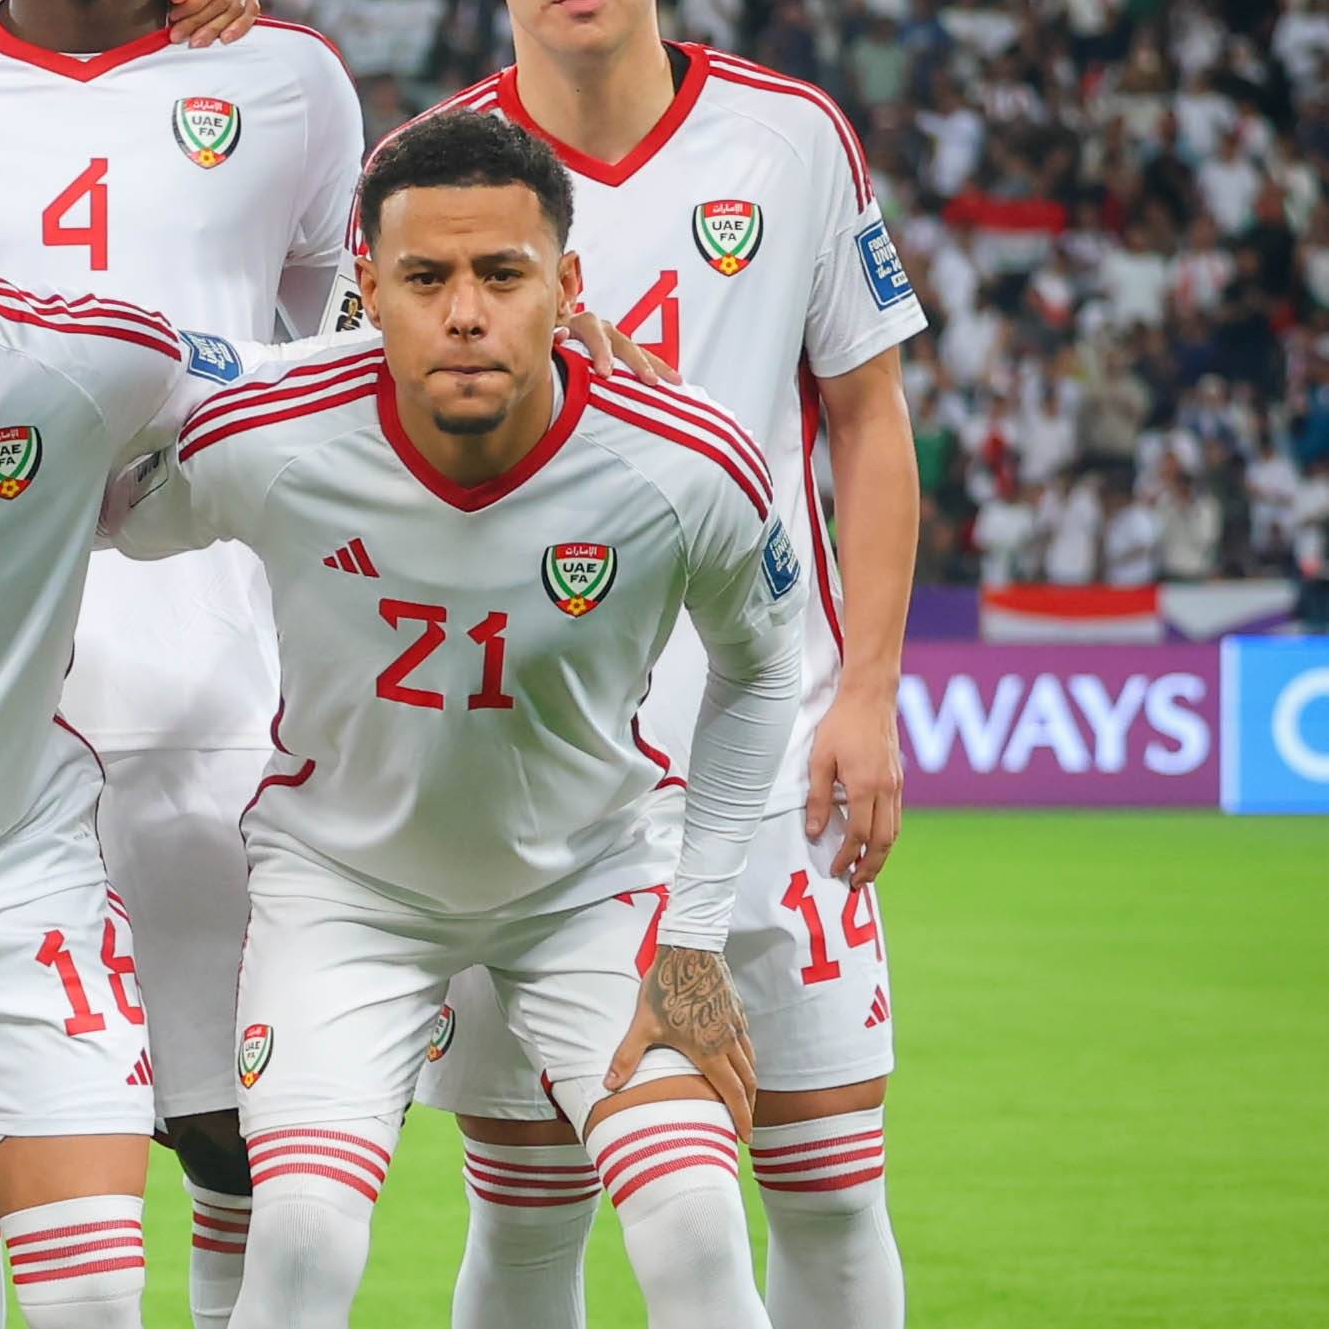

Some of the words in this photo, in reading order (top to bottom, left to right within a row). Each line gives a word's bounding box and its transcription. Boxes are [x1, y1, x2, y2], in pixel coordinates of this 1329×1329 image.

[191, 116, 223, 128] UAE
[198, 127, 217, 137] FA
[42, 158, 109, 271] 4
[711, 220, 744, 232] UAE
[719, 231, 737, 242] FA
[578, 270, 680, 375] 4
[562, 562, 598, 574] UAE
[569, 573, 588, 584] FA
[376, 598, 513, 710] 21
[898, 673, 1211, 775] WAYS
[782, 869, 882, 986] 14
[35, 917, 146, 1037] 16
